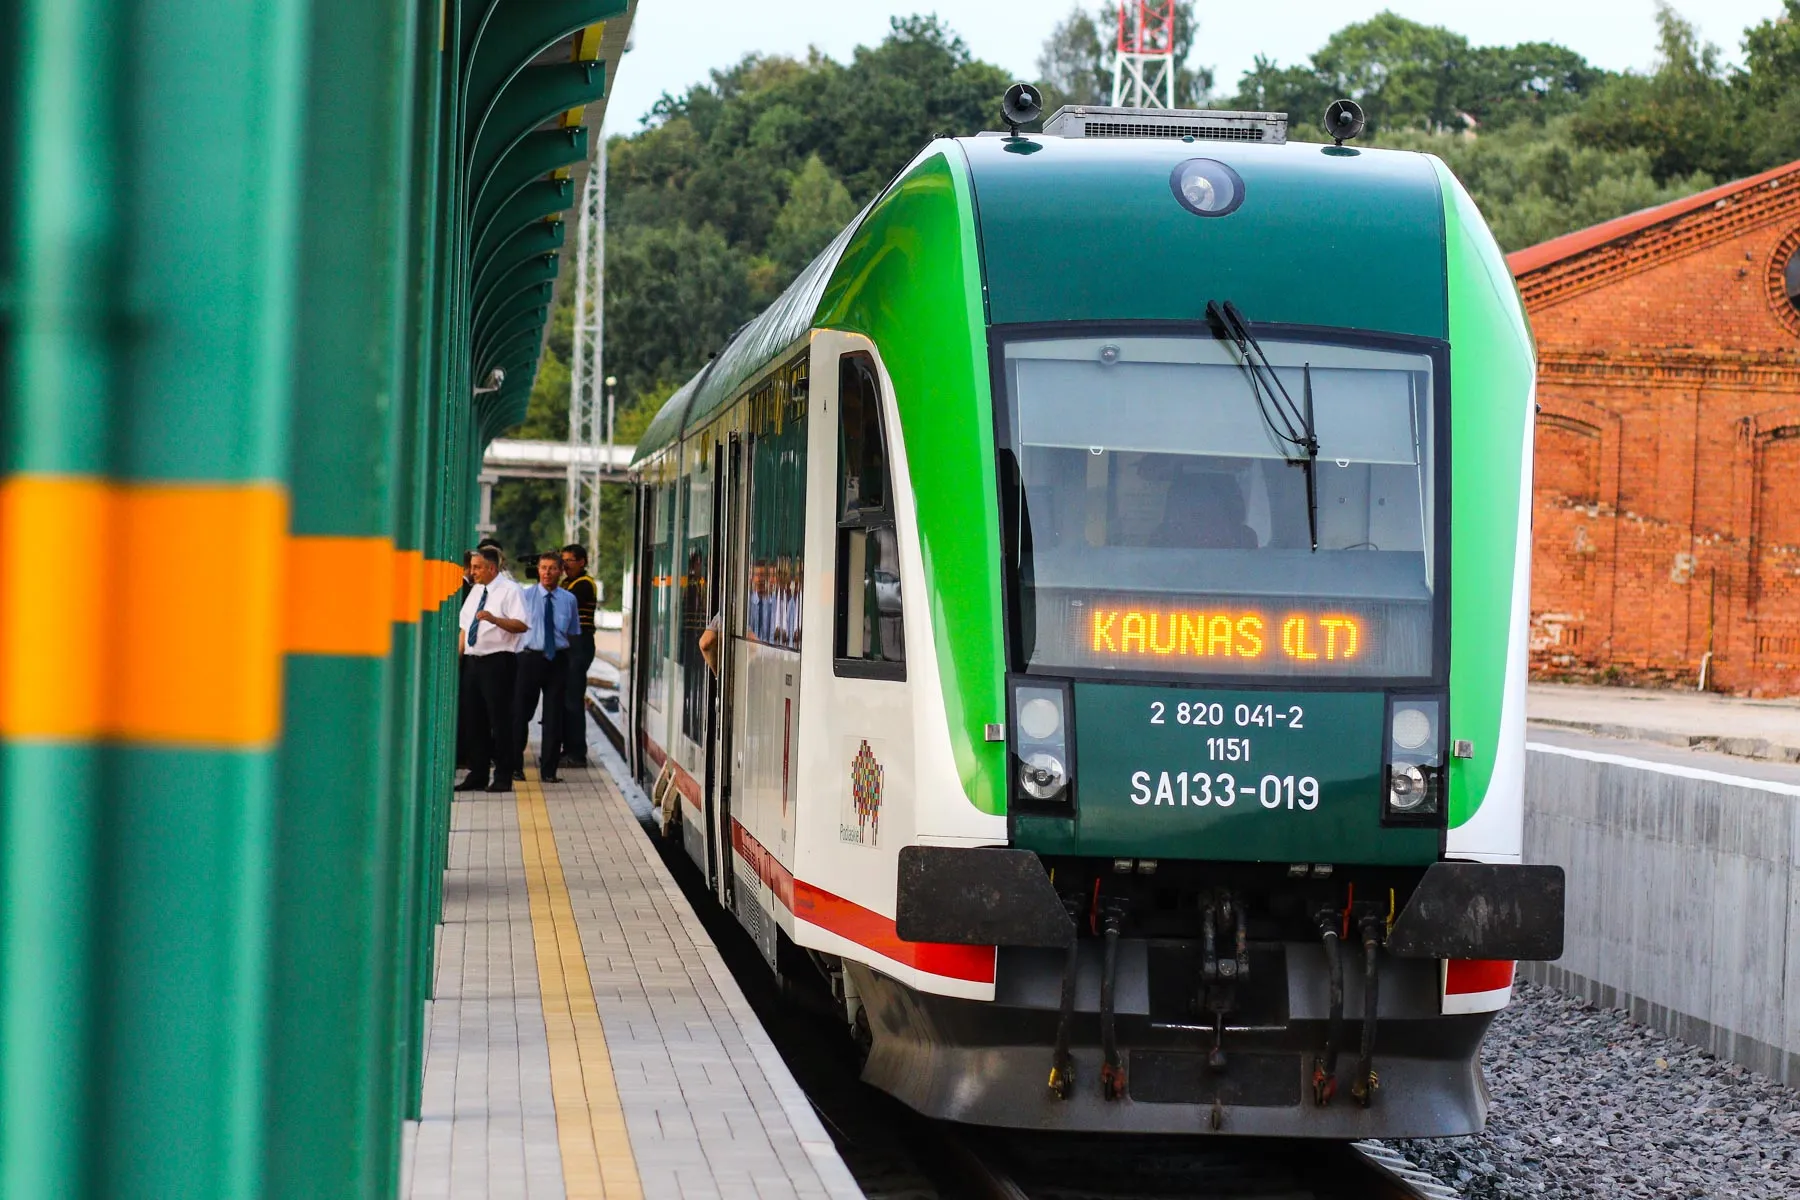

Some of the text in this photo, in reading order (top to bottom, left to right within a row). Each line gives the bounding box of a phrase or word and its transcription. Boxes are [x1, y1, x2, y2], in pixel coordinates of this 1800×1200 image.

[1092, 611, 1359, 661] KAUNAS (LT)
[1150, 701, 1304, 729] 2 820 041-2
[1206, 737, 1250, 762] 1151
[1130, 770, 1319, 811] SA133-019
